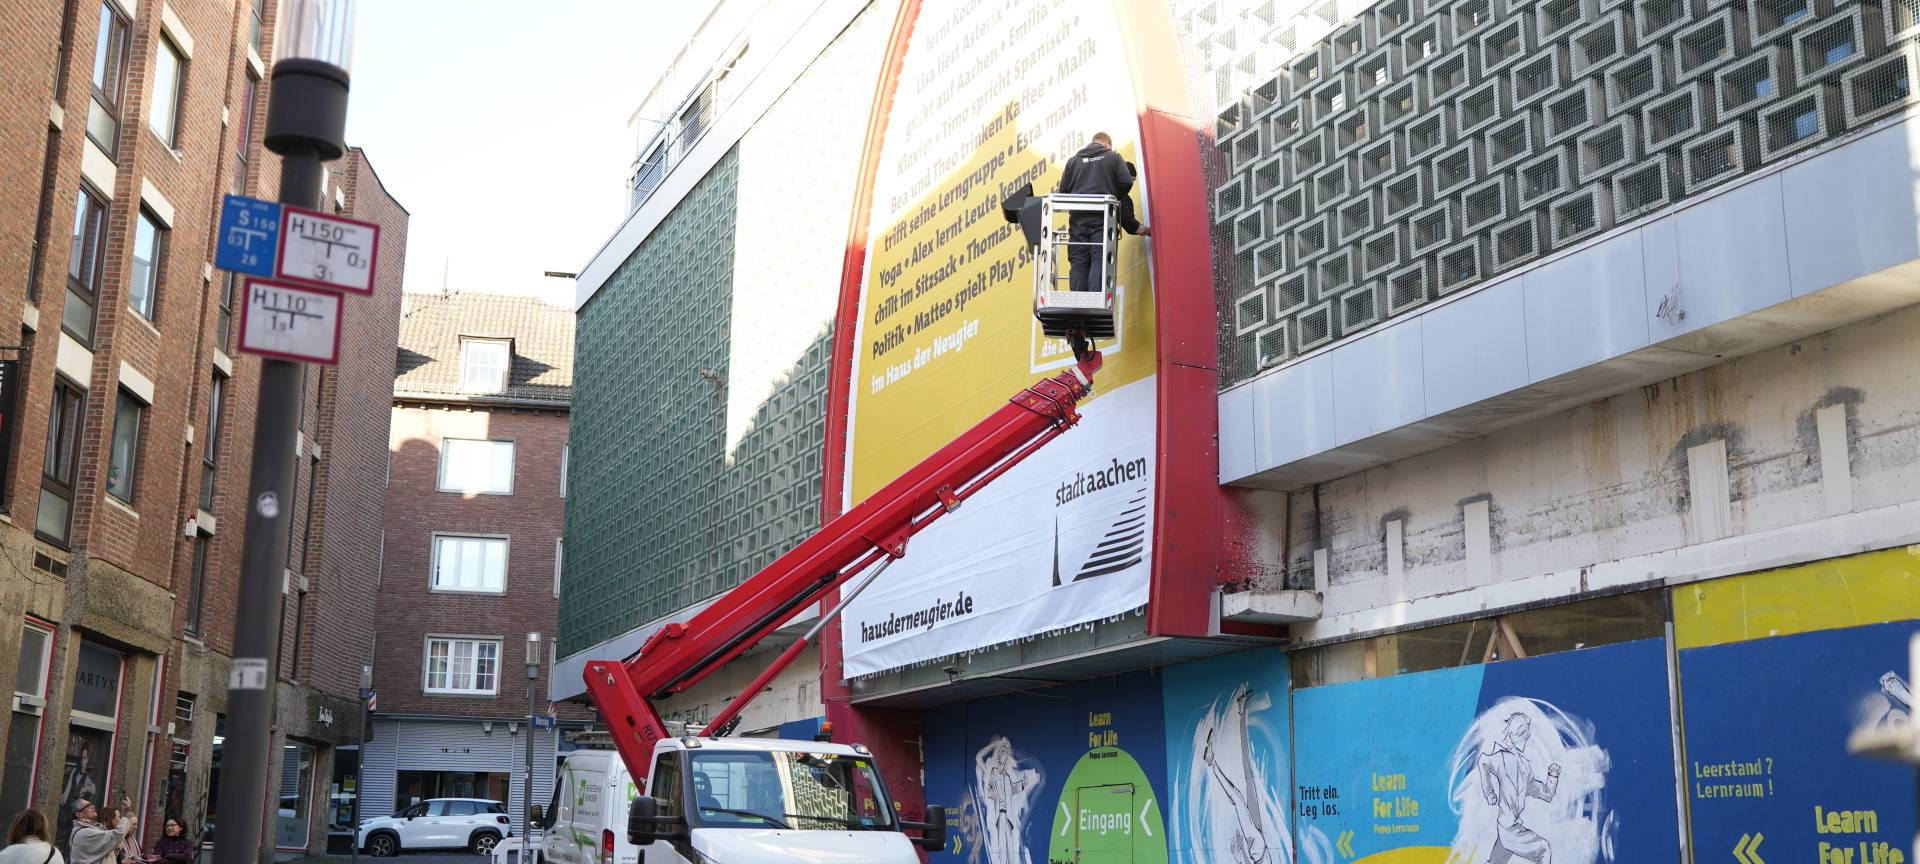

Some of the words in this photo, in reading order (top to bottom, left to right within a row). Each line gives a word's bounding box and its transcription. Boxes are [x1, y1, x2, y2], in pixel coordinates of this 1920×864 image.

[916, 68, 935, 95] Lisa
[938, 42, 960, 72] liest
[936, 85, 957, 109] auf
[957, 49, 998, 93] Aachen
[1009, 4, 1048, 48] Emilia
[942, 108, 968, 138] Timo
[970, 68, 1012, 115] spricht
[1014, 22, 1070, 80] Spanisch
[890, 193, 908, 215] Bea
[910, 173, 932, 201] und
[932, 148, 958, 185] Theo
[960, 117, 1003, 159] trinken
[1005, 87, 1046, 122] Kaffee
[1057, 38, 1097, 85] Malik
[884, 220, 908, 252] trifft
[909, 205, 936, 237] seine
[938, 154, 1005, 214] Lerngruppe
[1016, 125, 1043, 155] Esra
[1045, 84, 1088, 132] macht
[239, 209, 250, 227] S
[879, 260, 903, 289] Yoga
[911, 234, 935, 269] Alex
[935, 217, 963, 248] lernt
[965, 193, 998, 230] Leute
[1060, 130, 1085, 160] Ella
[874, 297, 899, 326] chillt
[900, 288, 914, 312] im
[915, 257, 957, 303] Sitzsack
[966, 222, 1012, 264] Thomas
[873, 320, 905, 360] Politik
[913, 298, 953, 337] Matteo
[954, 269, 987, 313] spielt
[989, 251, 1015, 287] Play
[870, 372, 883, 394] im
[885, 358, 912, 387] Haus
[913, 338, 933, 370] der
[933, 317, 980, 360] Neugier
[860, 590, 974, 644] hausderneugier.de
[78, 670, 115, 692] ARTYS
[1089, 711, 1112, 727] Learn
[1089, 731, 1102, 748] For
[1104, 729, 1118, 746] Life
[1372, 771, 1406, 792] Learn
[1694, 758, 1762, 778] Leerstand
[1300, 785, 1321, 801] Tritt
[1323, 784, 1340, 799] ein.
[1696, 782, 1764, 799] Lernraum
[1300, 802, 1318, 820] Leg
[1322, 801, 1340, 816] los.
[1373, 797, 1393, 818] For
[1395, 796, 1419, 818] Life
[1814, 805, 1878, 834] Learn
[1079, 808, 1132, 835] Eingang
[1818, 841, 1855, 864] For
[1859, 841, 1905, 864] Life
